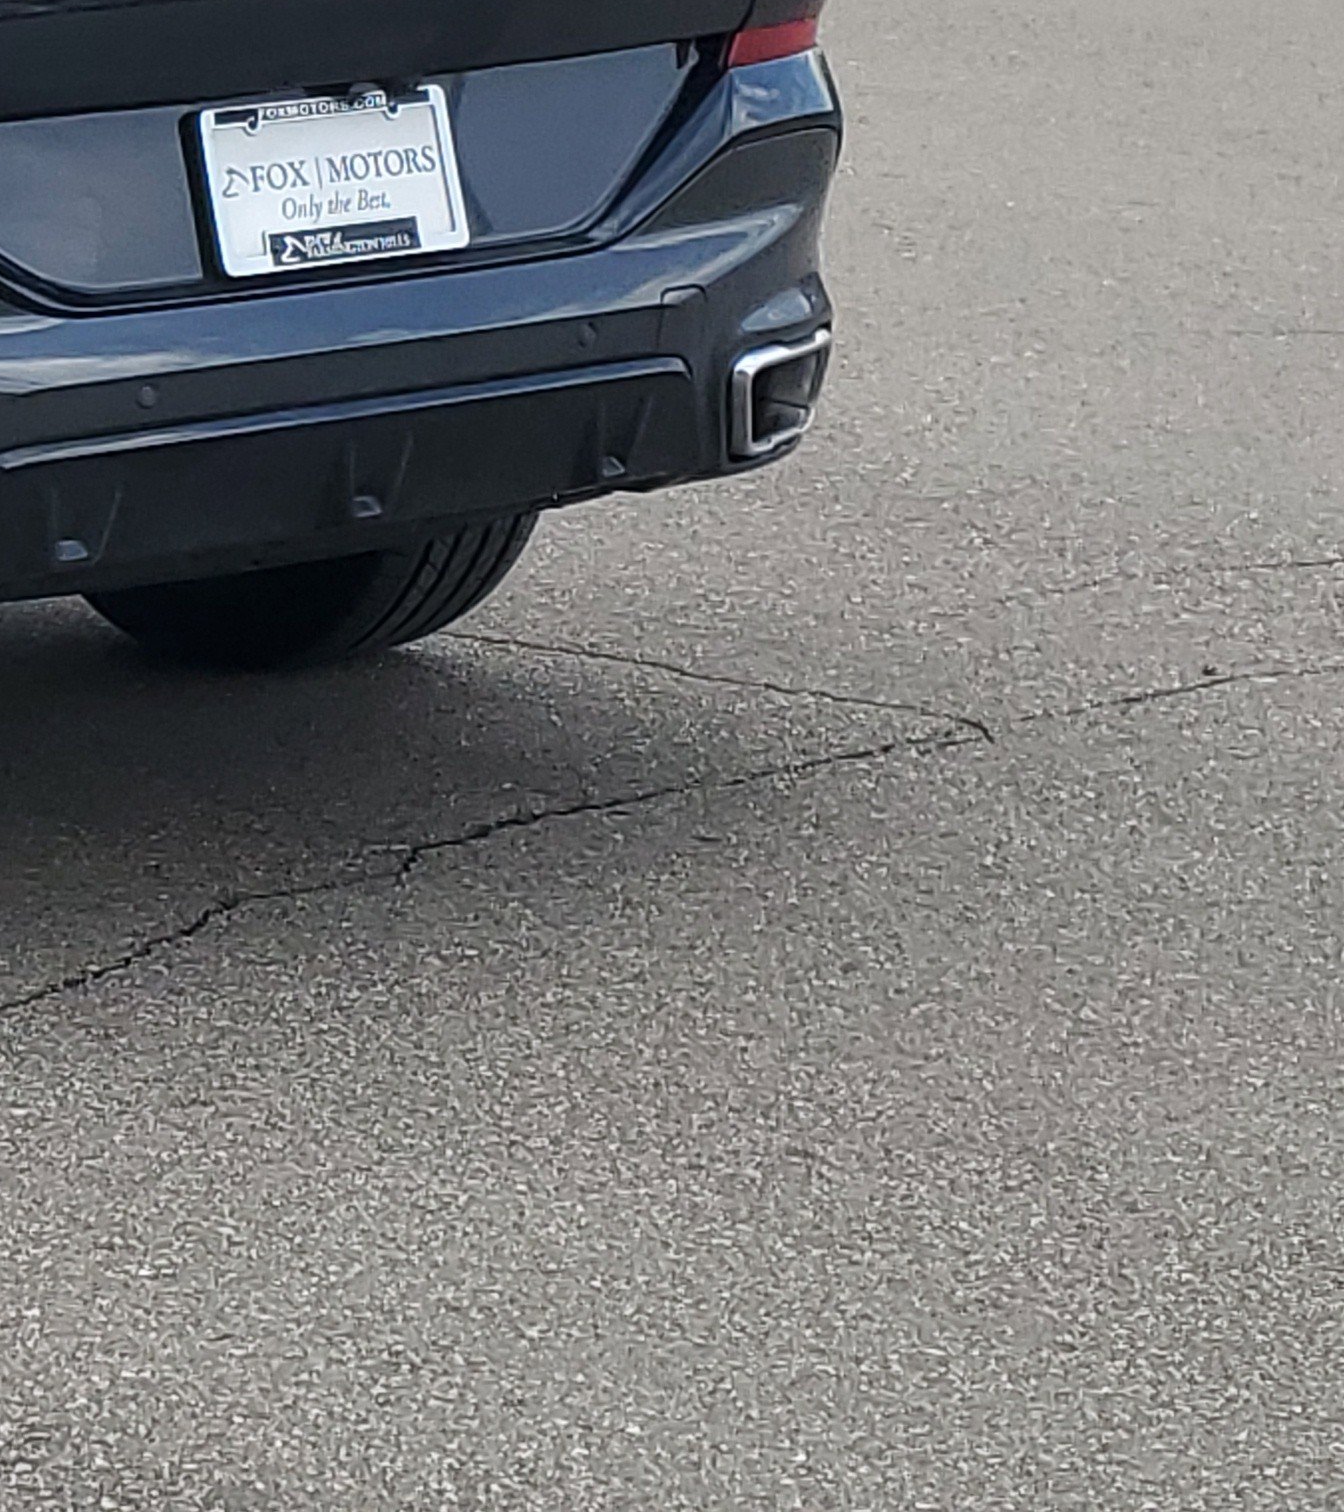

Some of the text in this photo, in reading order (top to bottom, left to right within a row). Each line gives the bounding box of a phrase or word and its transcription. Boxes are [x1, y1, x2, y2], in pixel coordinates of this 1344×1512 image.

[250, 144, 436, 192] FOX MOTORS
[281, 192, 323, 223] Only
[326, 190, 353, 215] the
